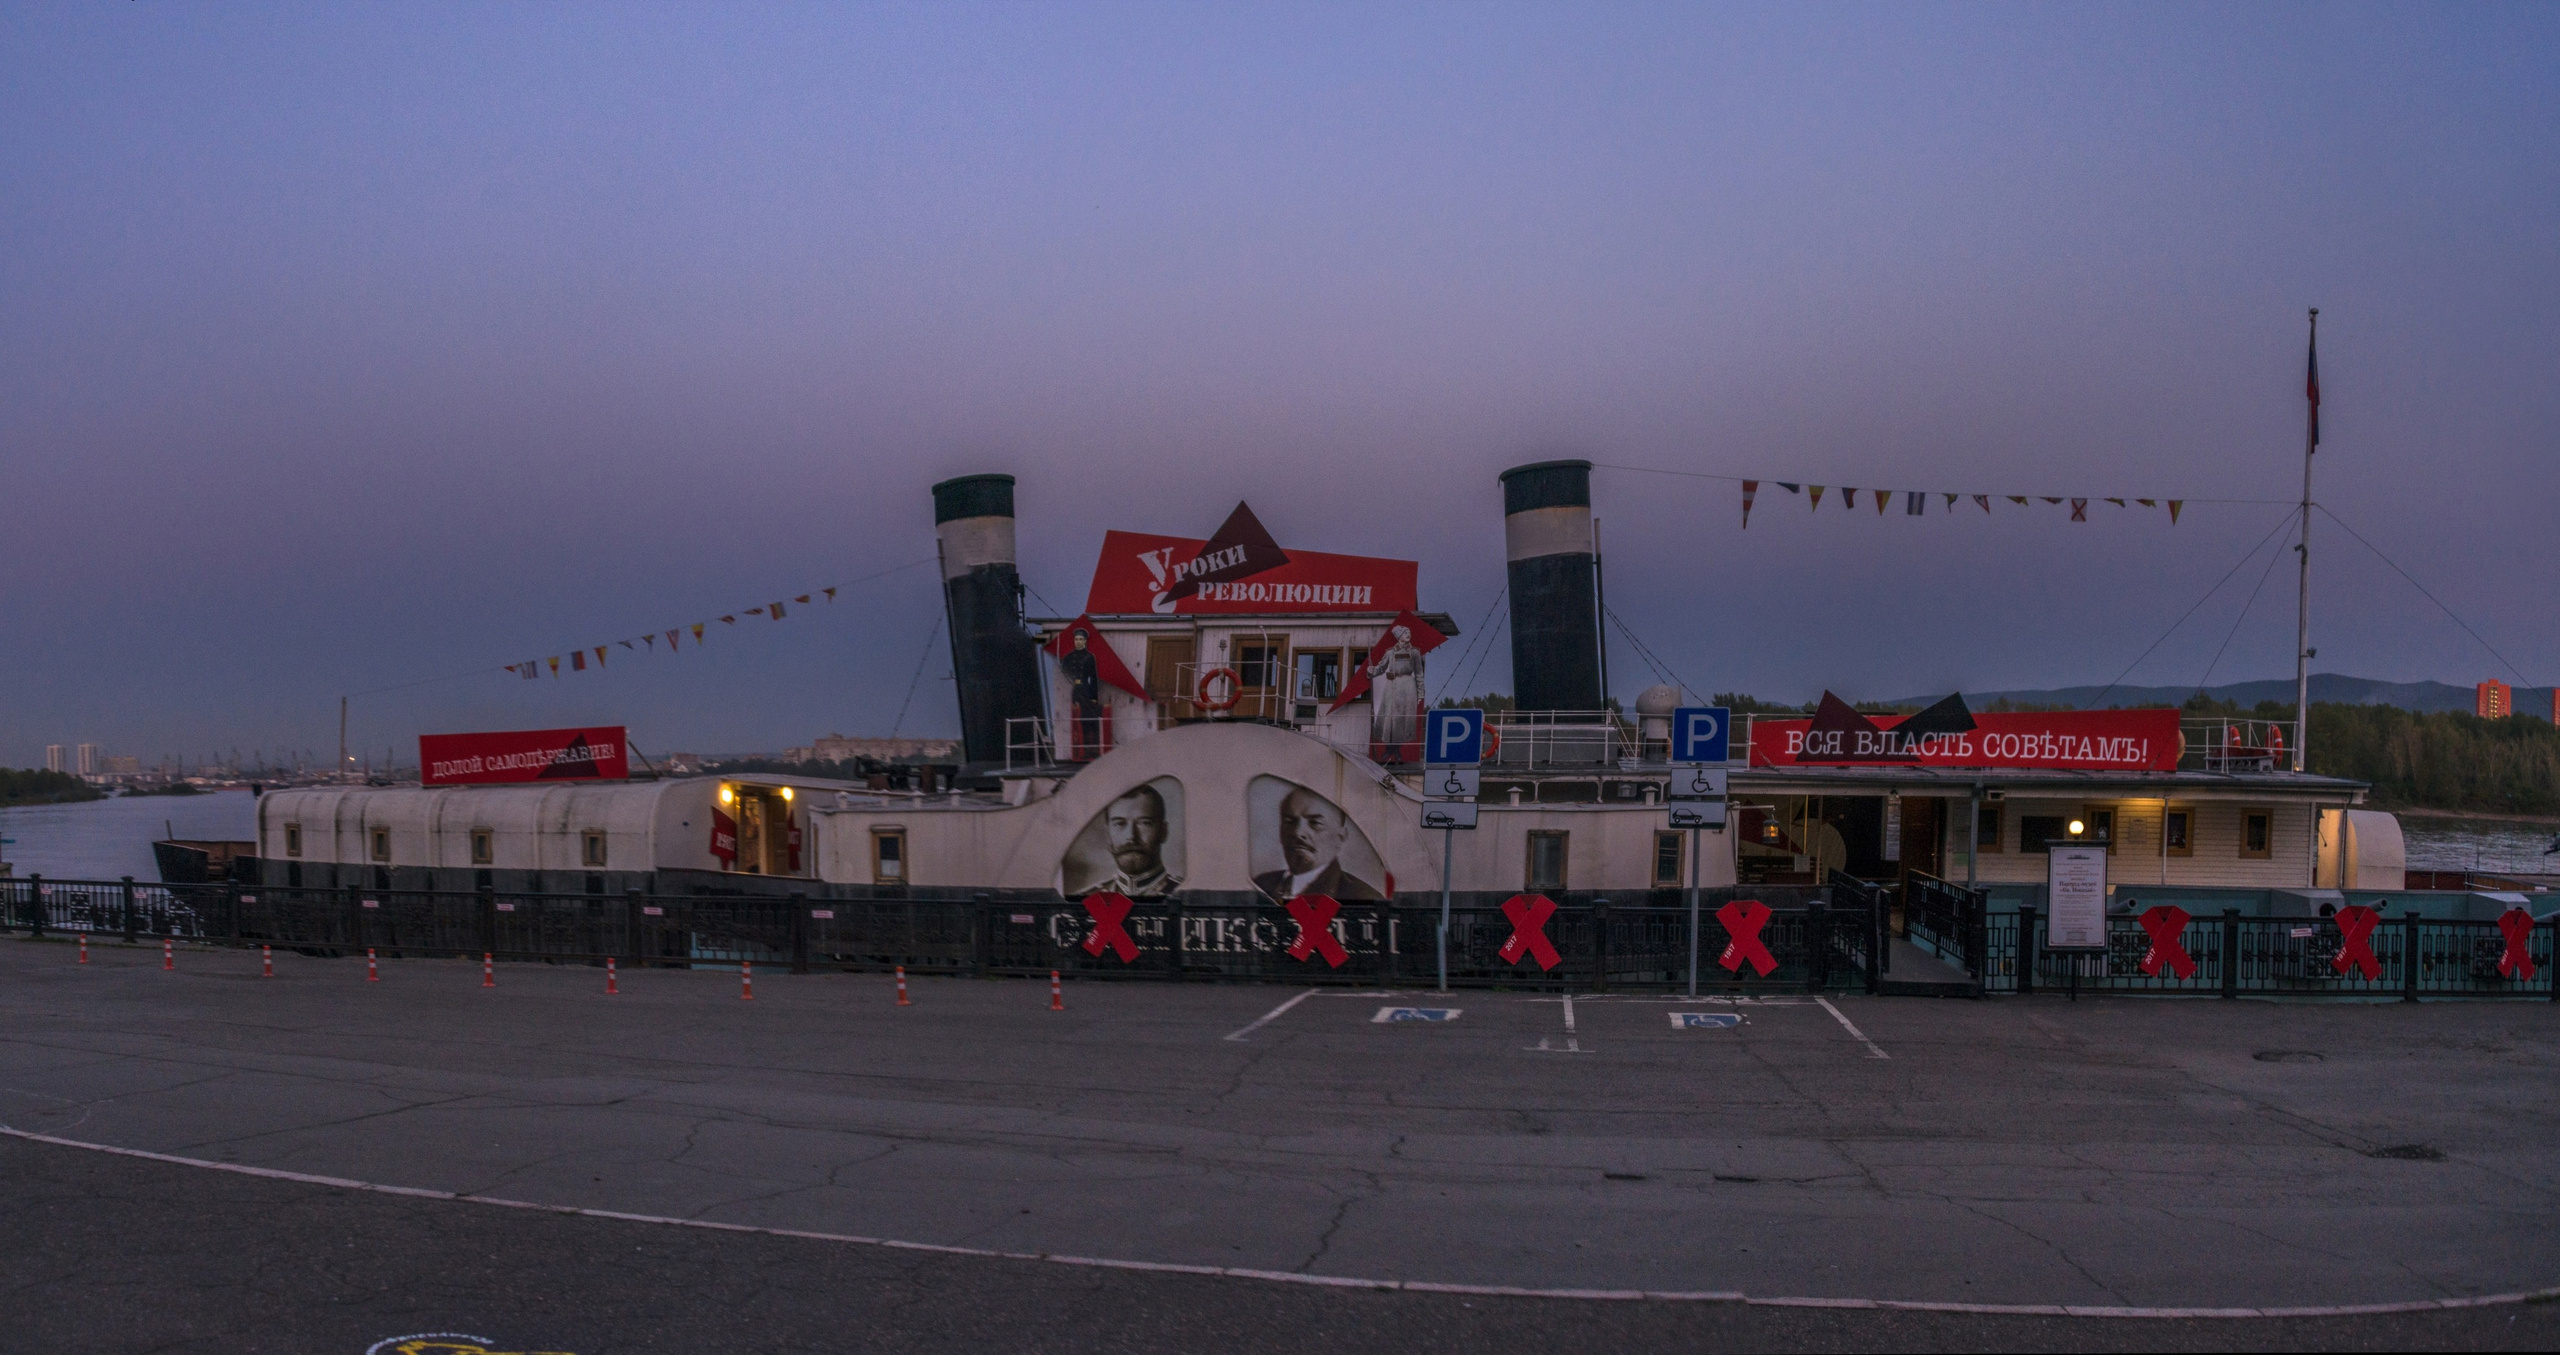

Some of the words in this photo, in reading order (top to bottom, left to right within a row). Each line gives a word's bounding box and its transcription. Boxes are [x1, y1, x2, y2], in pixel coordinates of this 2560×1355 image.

[1197, 582, 1372, 605] РЕВОЛЮЦИИ
[1440, 716, 1471, 758] P
[1687, 714, 1718, 756] P
[1785, 730, 1844, 755] ВСЯ
[1854, 731, 1973, 757] ВЛАСТЬ
[432, 755, 484, 779] ДОЛОЙ
[1505, 935, 1517, 951] 2017
[1724, 943, 1735, 959] 1917
[2336, 946, 2347, 962] 1917
[2145, 947, 2156, 965] 2017
